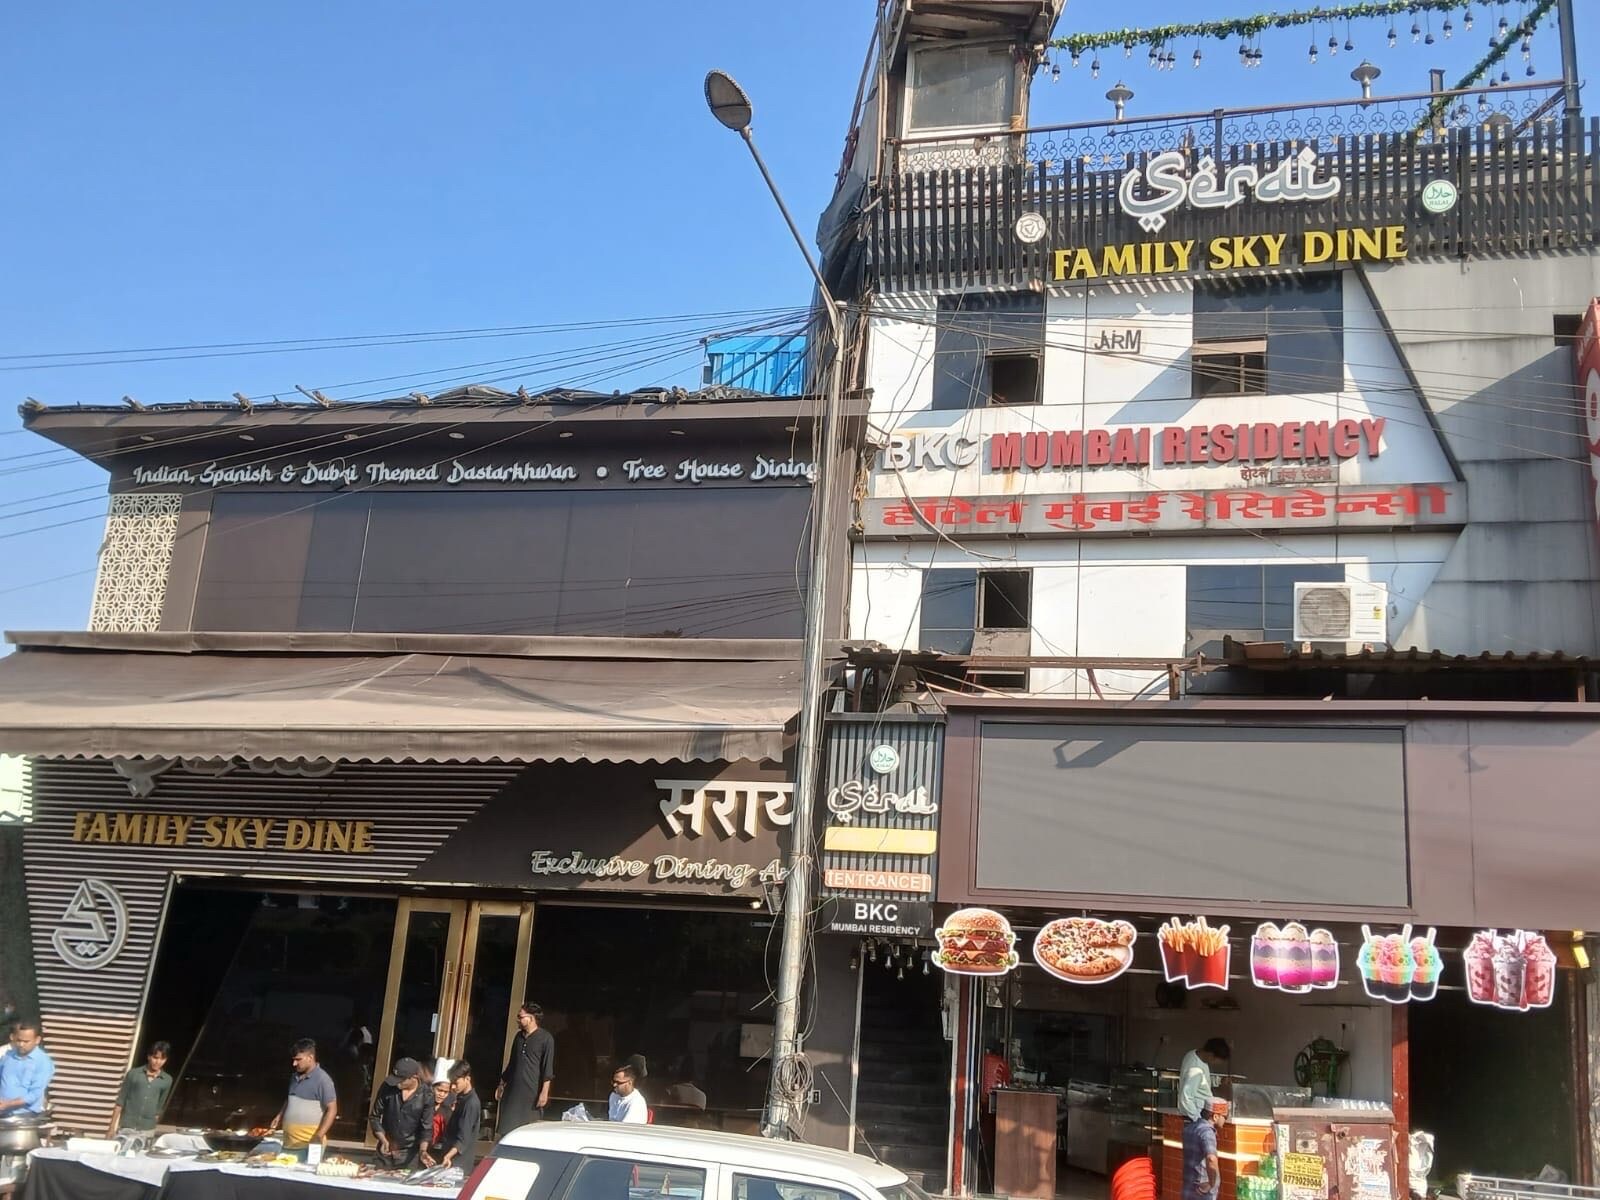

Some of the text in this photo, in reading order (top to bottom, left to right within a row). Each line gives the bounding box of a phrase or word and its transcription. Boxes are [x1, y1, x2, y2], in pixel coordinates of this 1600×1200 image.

[1053, 226, 1409, 281] FAMILY SKY DINE
[882, 417, 1386, 471] BKC MUMBAI RESIDENCY
[199, 461, 273, 485] Spanish
[280, 466, 296, 482] &
[366, 460, 439, 483] Themed
[447, 459, 577, 484] Dastarkhwan
[622, 458, 667, 480] Tree
[674, 457, 746, 483] House
[750, 455, 819, 484] Dining
[73, 812, 375, 853] FAMILY SKY DINE
[531, 851, 648, 877] Exclusive
[653, 855, 755, 888] Dining
[835, 873, 922, 889] ENTRANCE
[854, 903, 899, 921] BKC
[831, 923, 920, 935] MUMBAI RESIDENCY
